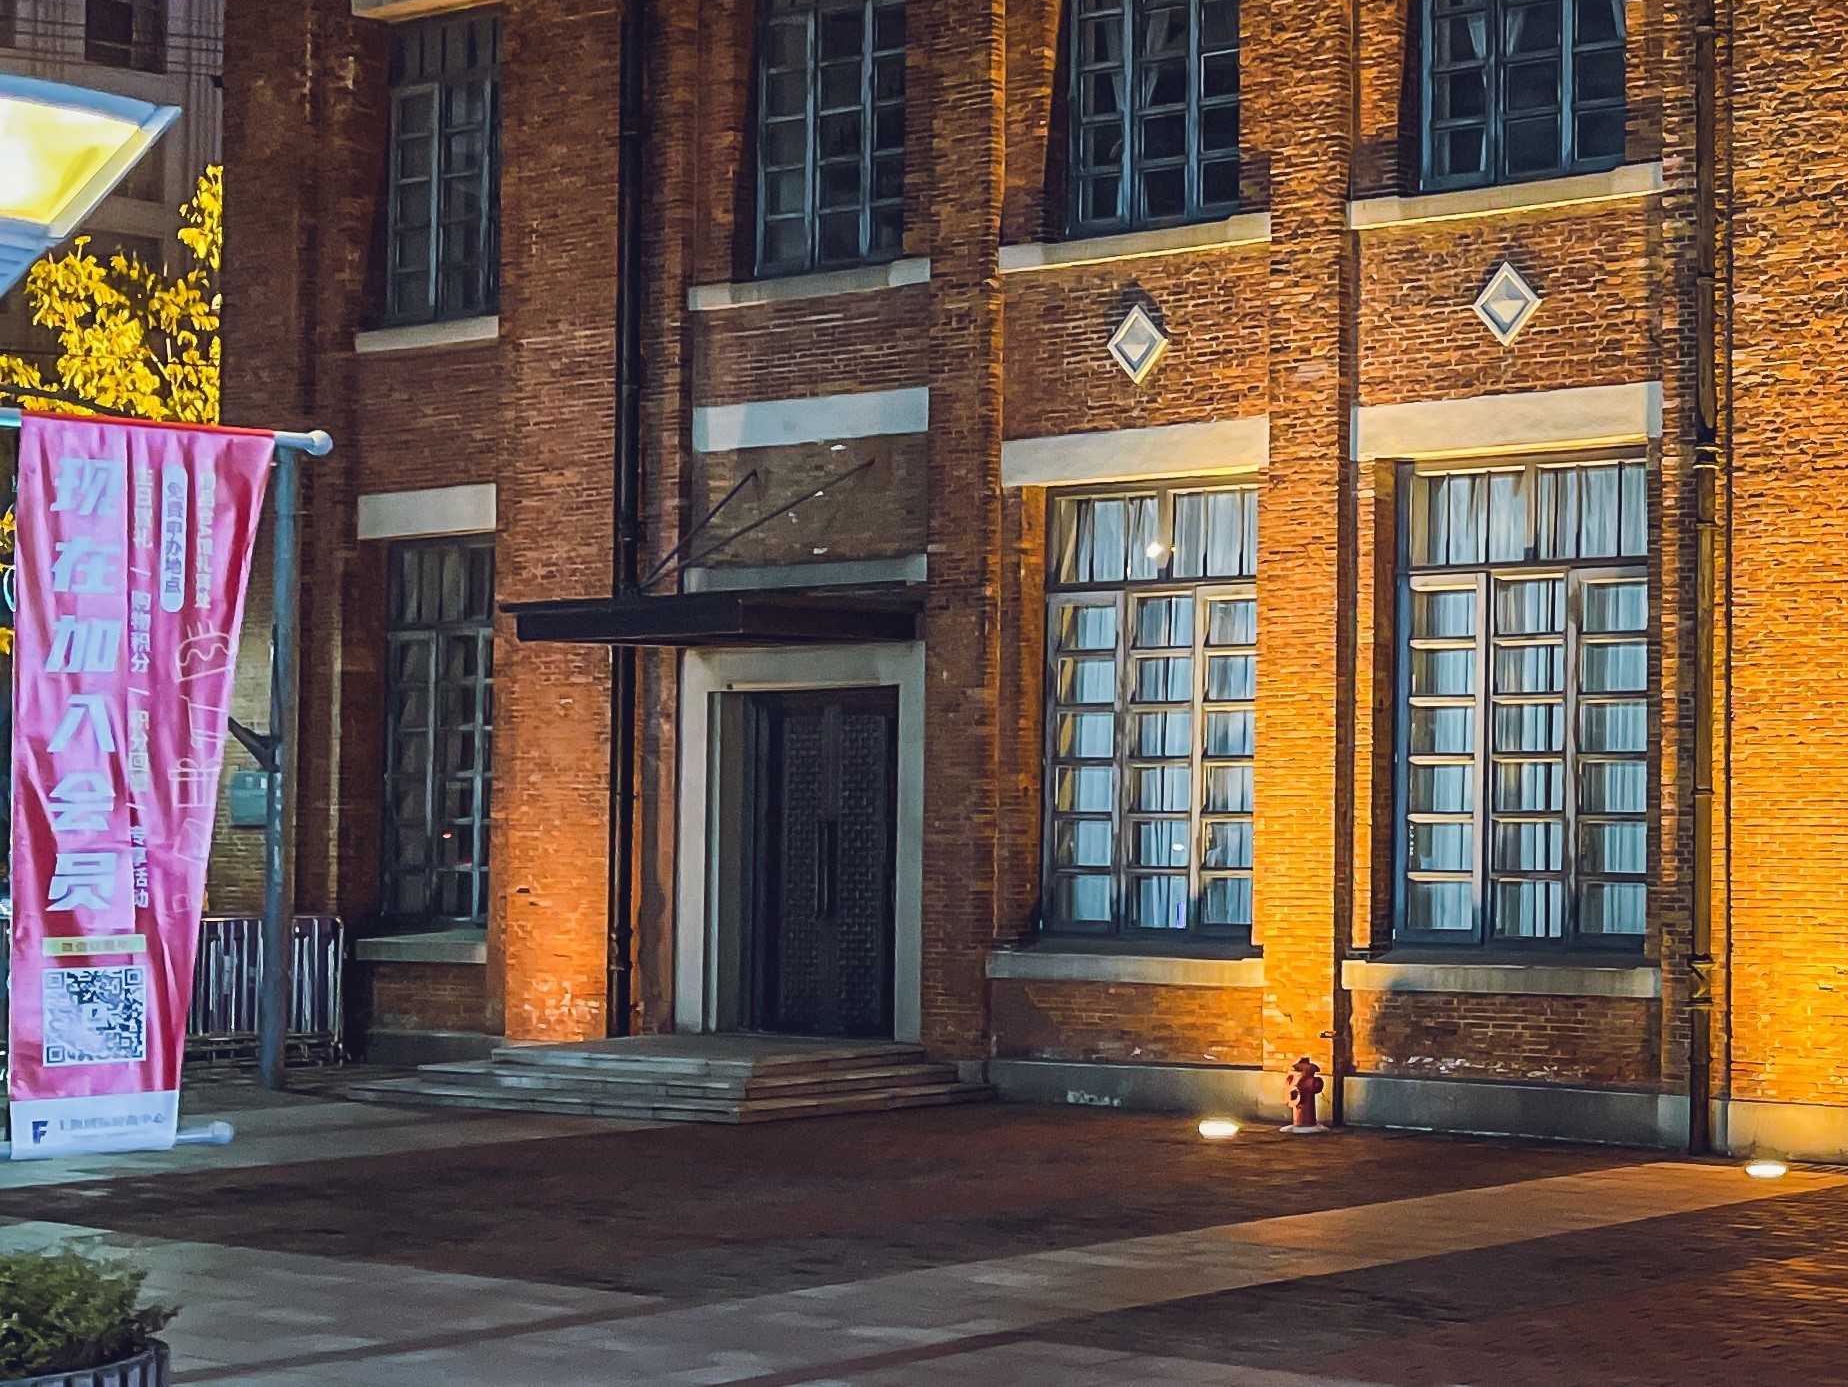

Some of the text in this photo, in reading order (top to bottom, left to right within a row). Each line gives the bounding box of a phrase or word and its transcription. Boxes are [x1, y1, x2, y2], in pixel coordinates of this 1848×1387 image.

[45, 458, 122, 912] 现在加入会员
